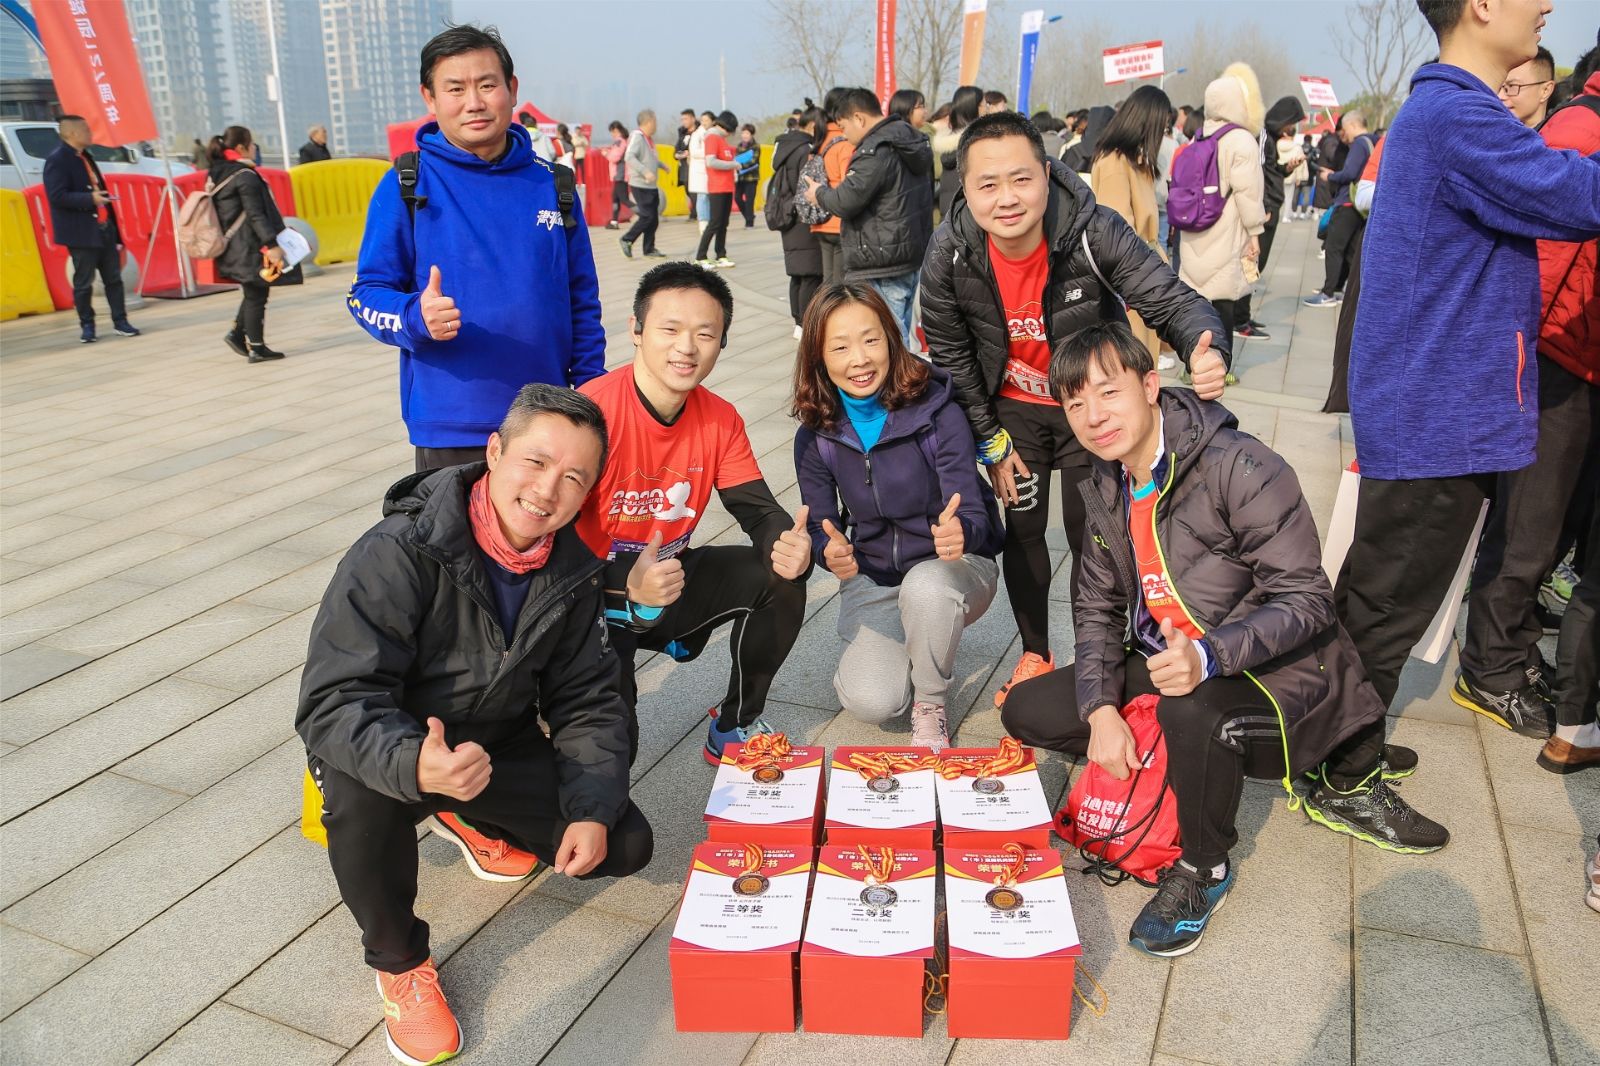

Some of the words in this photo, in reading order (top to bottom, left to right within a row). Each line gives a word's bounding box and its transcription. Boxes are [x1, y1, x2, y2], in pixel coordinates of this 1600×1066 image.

[608, 488, 665, 516] 2020
[723, 904, 764, 914] 三等奖
[851, 908, 892, 918] 二等奖
[990, 910, 1031, 919] 三等奖
